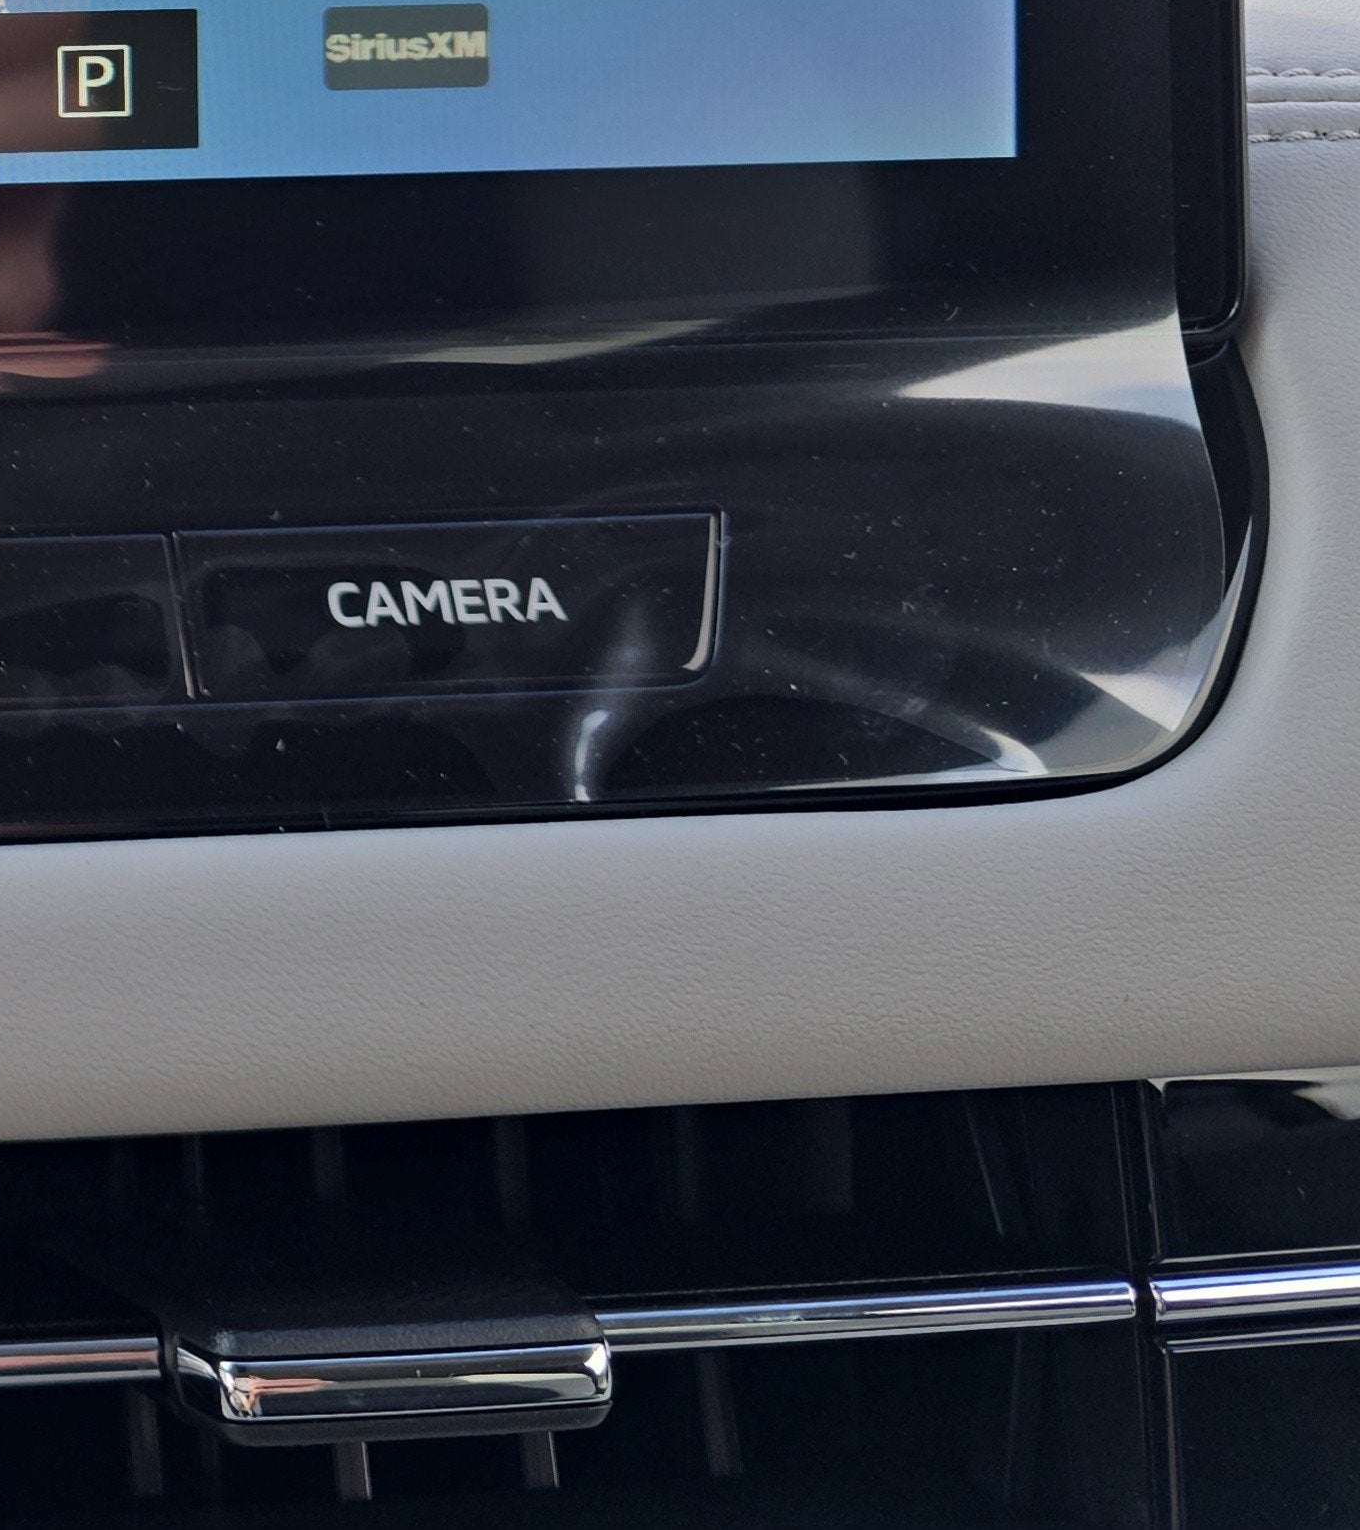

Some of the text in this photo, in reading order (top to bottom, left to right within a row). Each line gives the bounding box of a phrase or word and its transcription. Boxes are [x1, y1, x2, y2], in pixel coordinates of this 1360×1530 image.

[325, 30, 488, 63] SiriusXM
[76, 56, 114, 107] P
[327, 577, 569, 628] CAMERA
